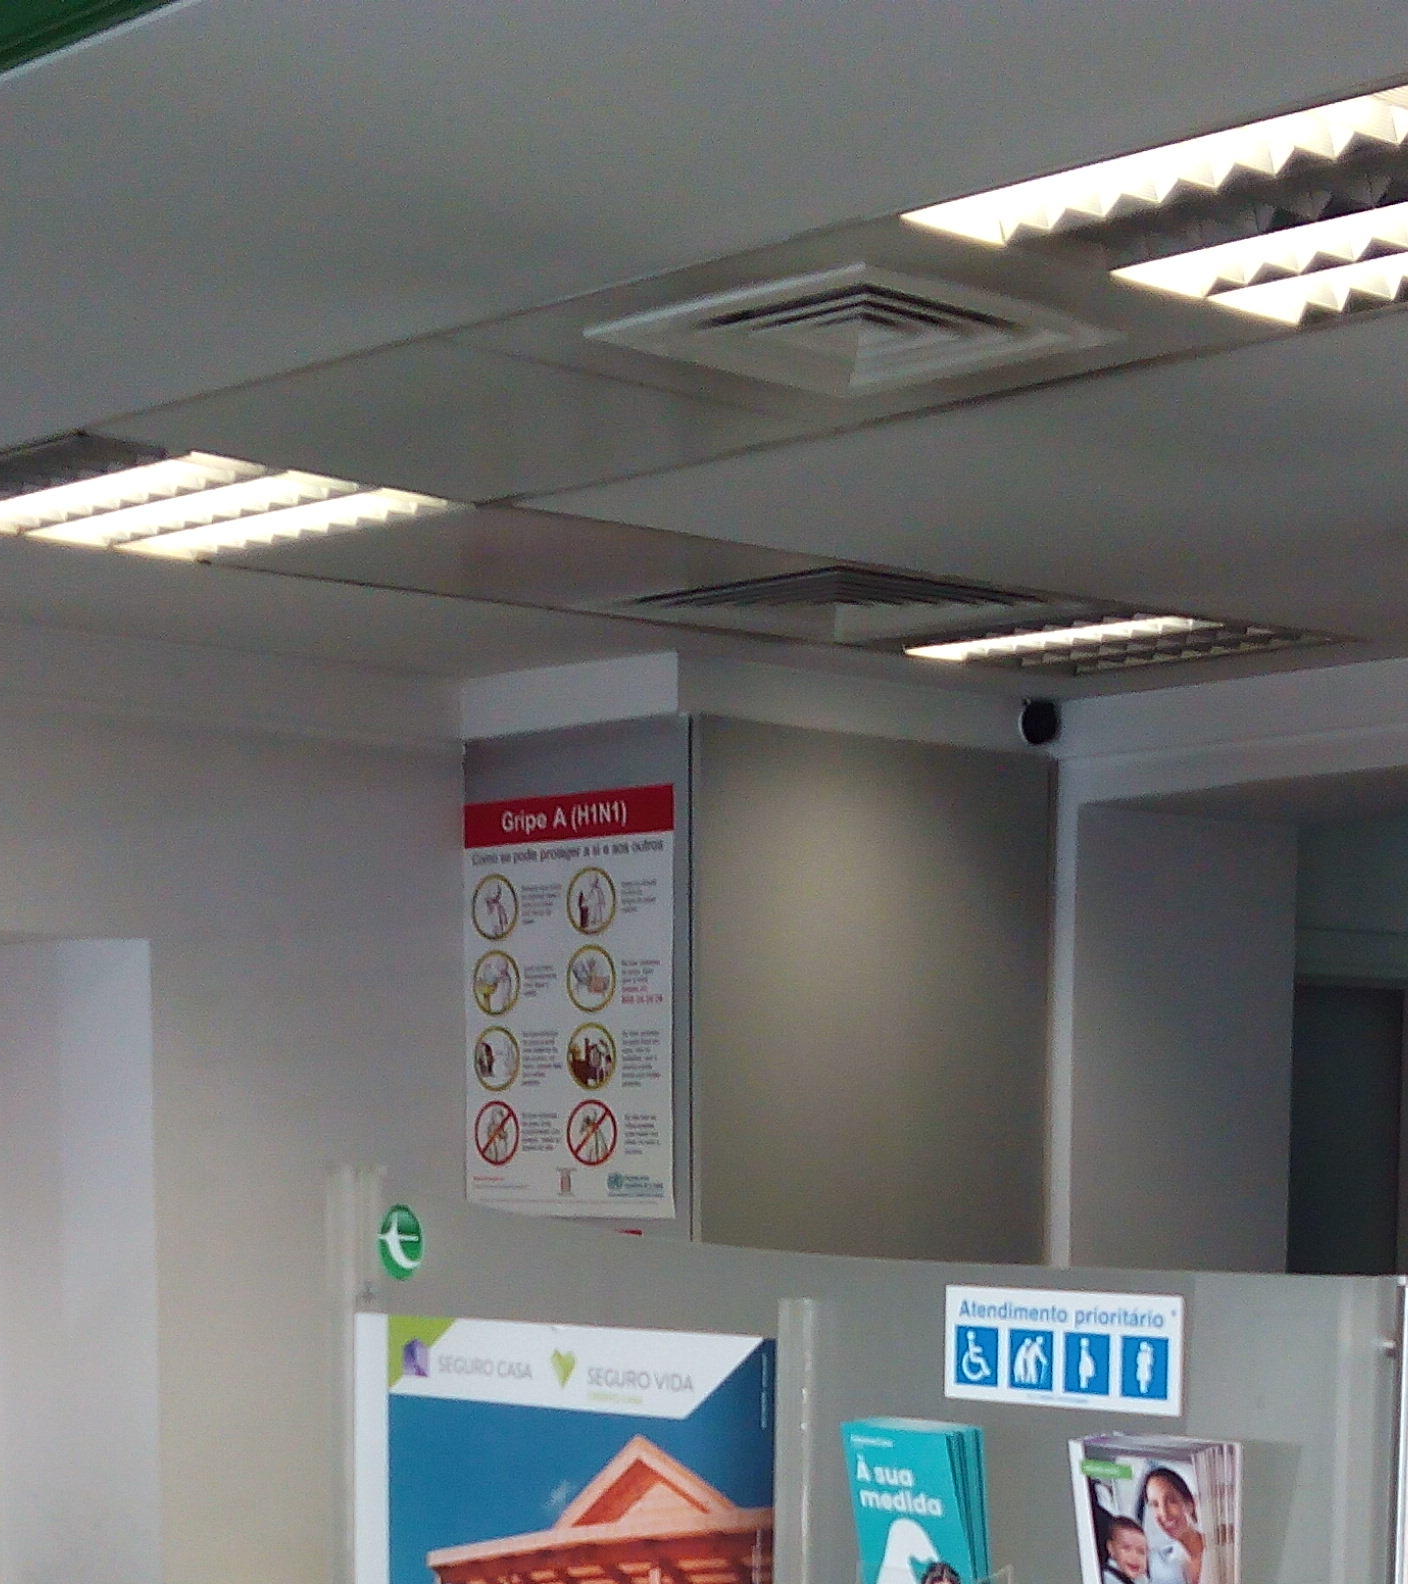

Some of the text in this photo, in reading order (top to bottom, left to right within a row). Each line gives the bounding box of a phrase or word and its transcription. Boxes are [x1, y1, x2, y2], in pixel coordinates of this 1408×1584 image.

[501, 800, 628, 835] Gripe A (H1N1)
[632, 838, 664, 853] outros
[959, 1300, 1164, 1329] Atendimento prioritário
[438, 1357, 532, 1380] SEGURO CASA
[586, 1368, 693, 1393] SEGURO VIDA
[874, 1465, 914, 1488] sua
[859, 1489, 942, 1517] medida
